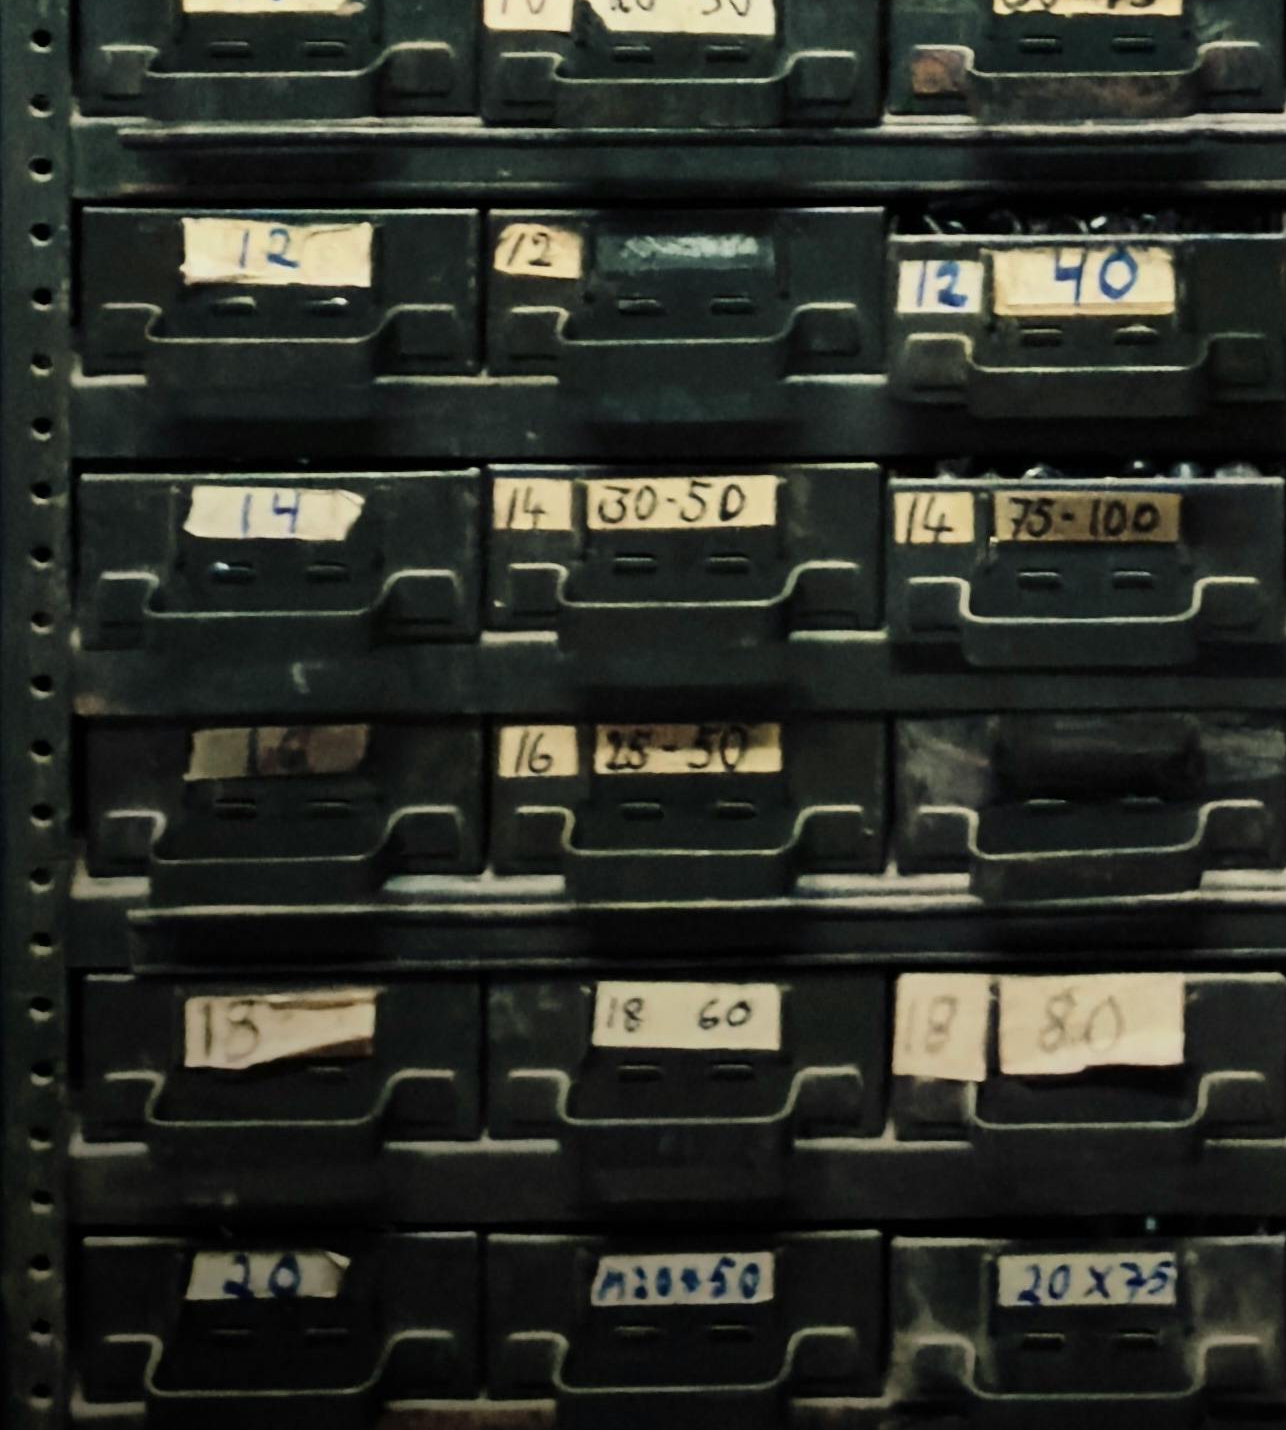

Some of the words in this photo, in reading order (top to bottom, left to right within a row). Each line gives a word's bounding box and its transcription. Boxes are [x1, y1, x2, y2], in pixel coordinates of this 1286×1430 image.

[239, 229, 299, 267] 12
[506, 231, 554, 267] 12
[915, 262, 965, 307] 12
[1054, 245, 1137, 306] 40
[241, 492, 298, 532] 14
[508, 486, 549, 528] 14
[905, 497, 954, 542] 14
[514, 732, 554, 773] 16
[605, 996, 646, 1033] 18
[697, 997, 752, 1030] 60
[1037, 986, 1126, 1052] 80
[223, 1252, 301, 1299] 20
